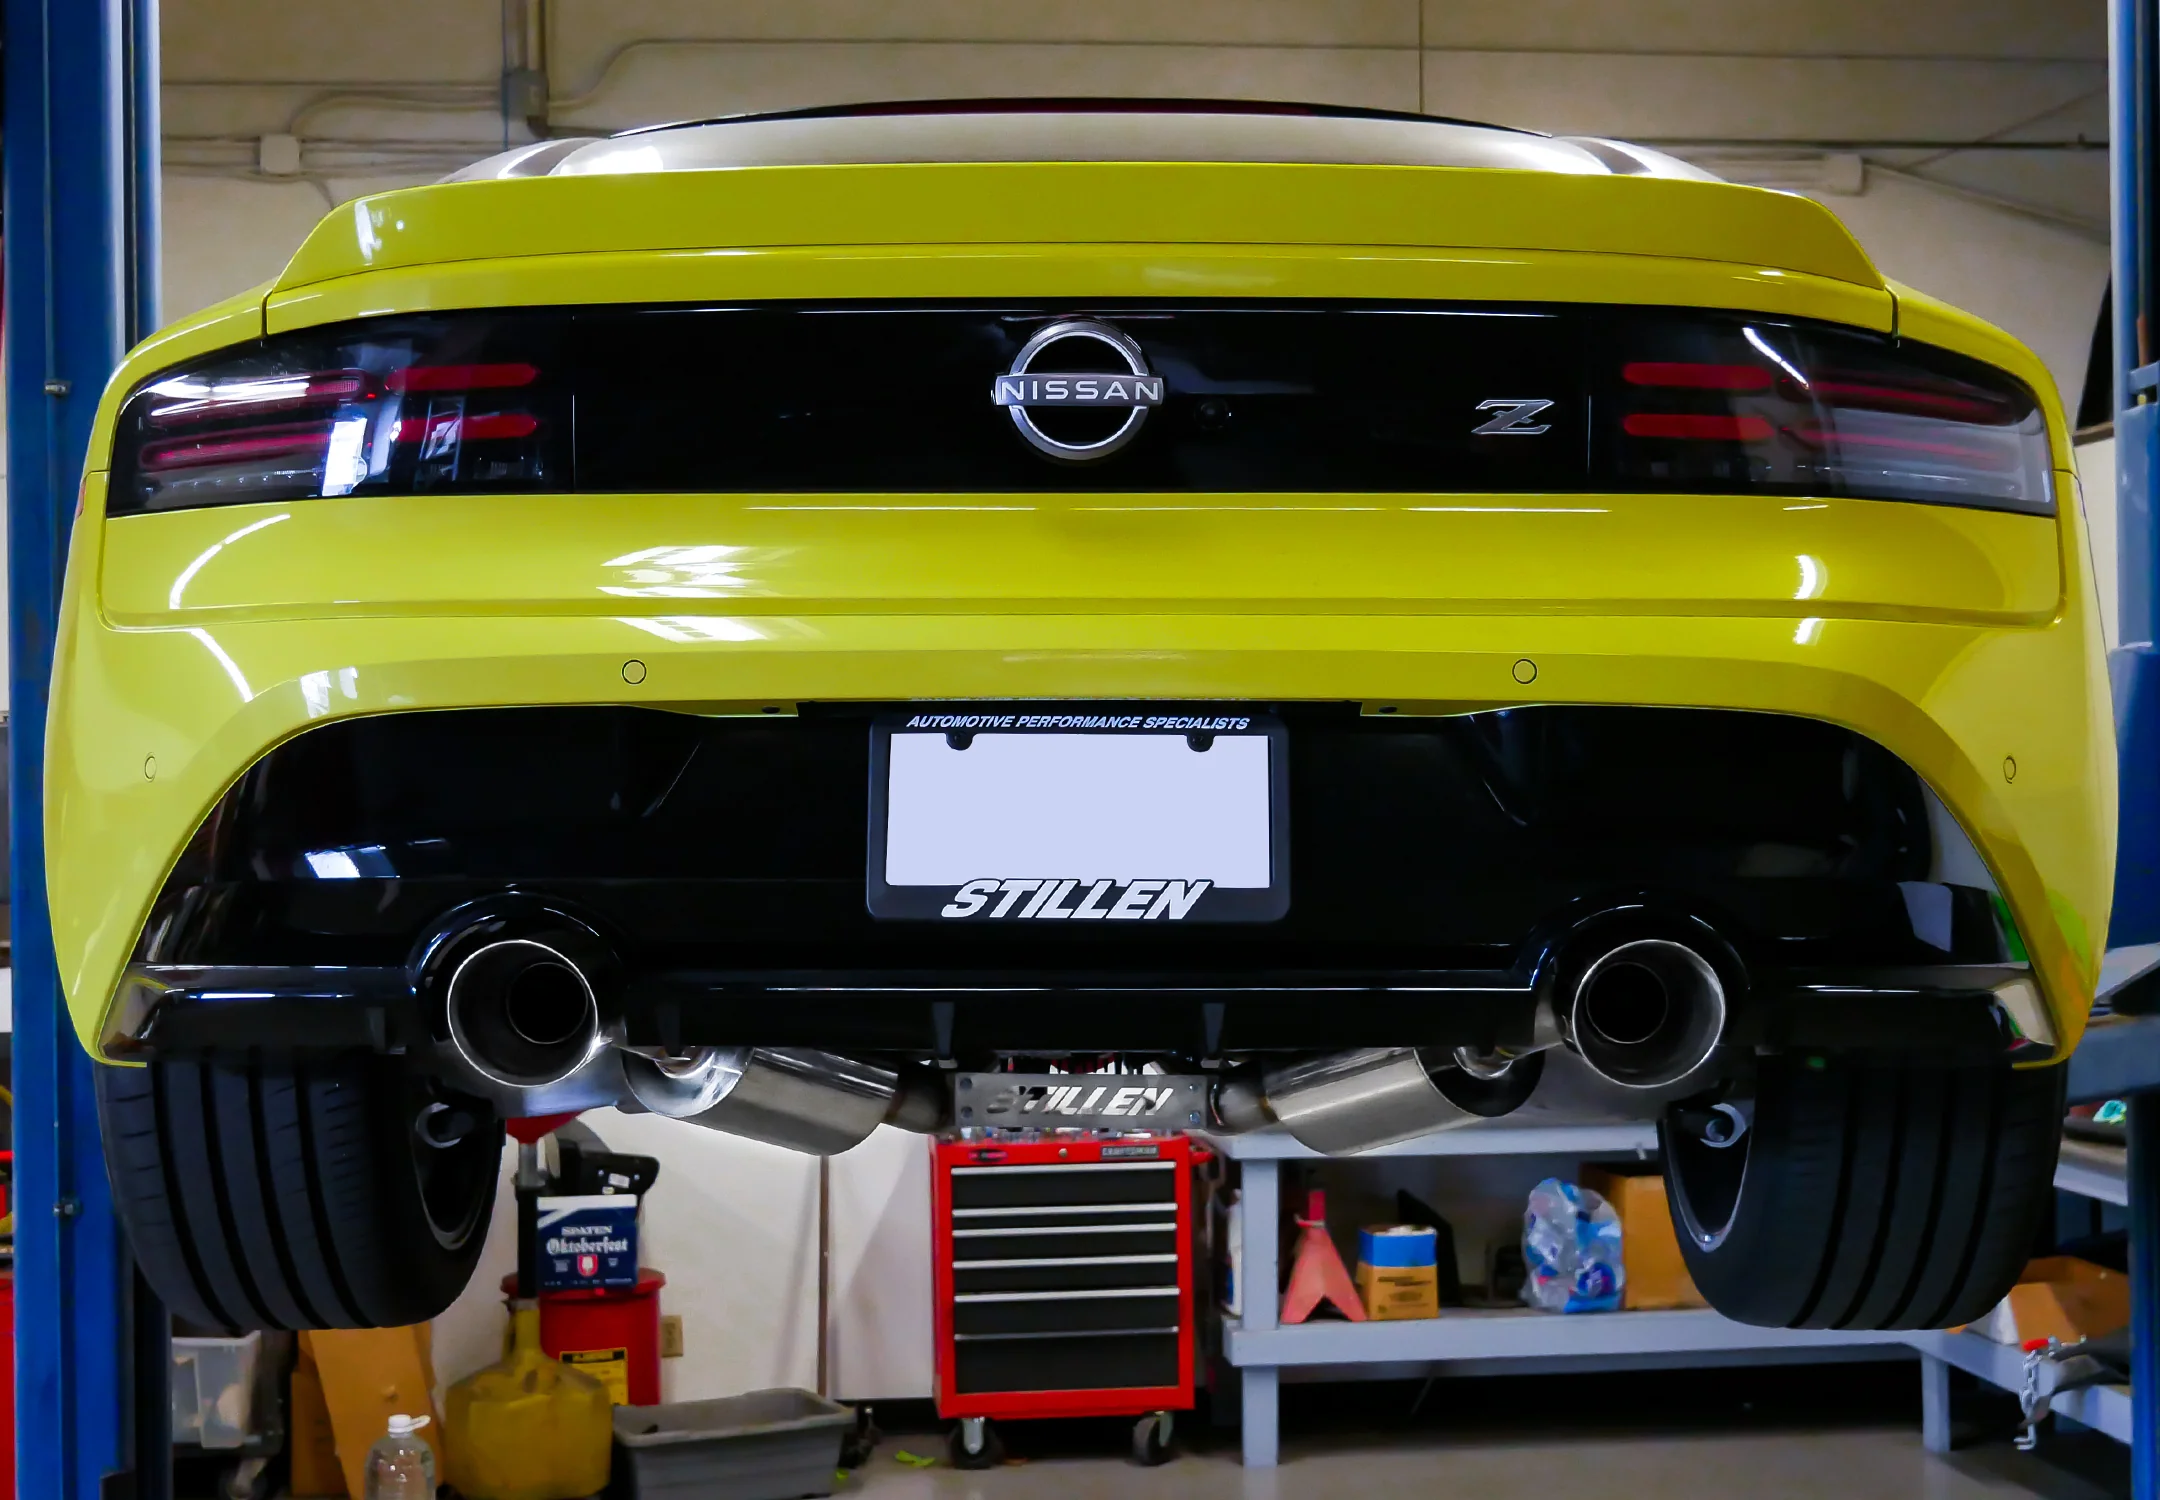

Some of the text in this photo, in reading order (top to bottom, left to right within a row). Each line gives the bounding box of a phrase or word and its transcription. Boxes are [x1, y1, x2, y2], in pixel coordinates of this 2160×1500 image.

[1000, 380, 1159, 401] NISSAN
[1470, 399, 1555, 435] Z
[906, 714, 1251, 730] AUTOMOTIVE PERFORMANCE SPECIALISTS
[940, 879, 1212, 920] STILLEN
[546, 1236, 628, 1255] Oktoberfest
